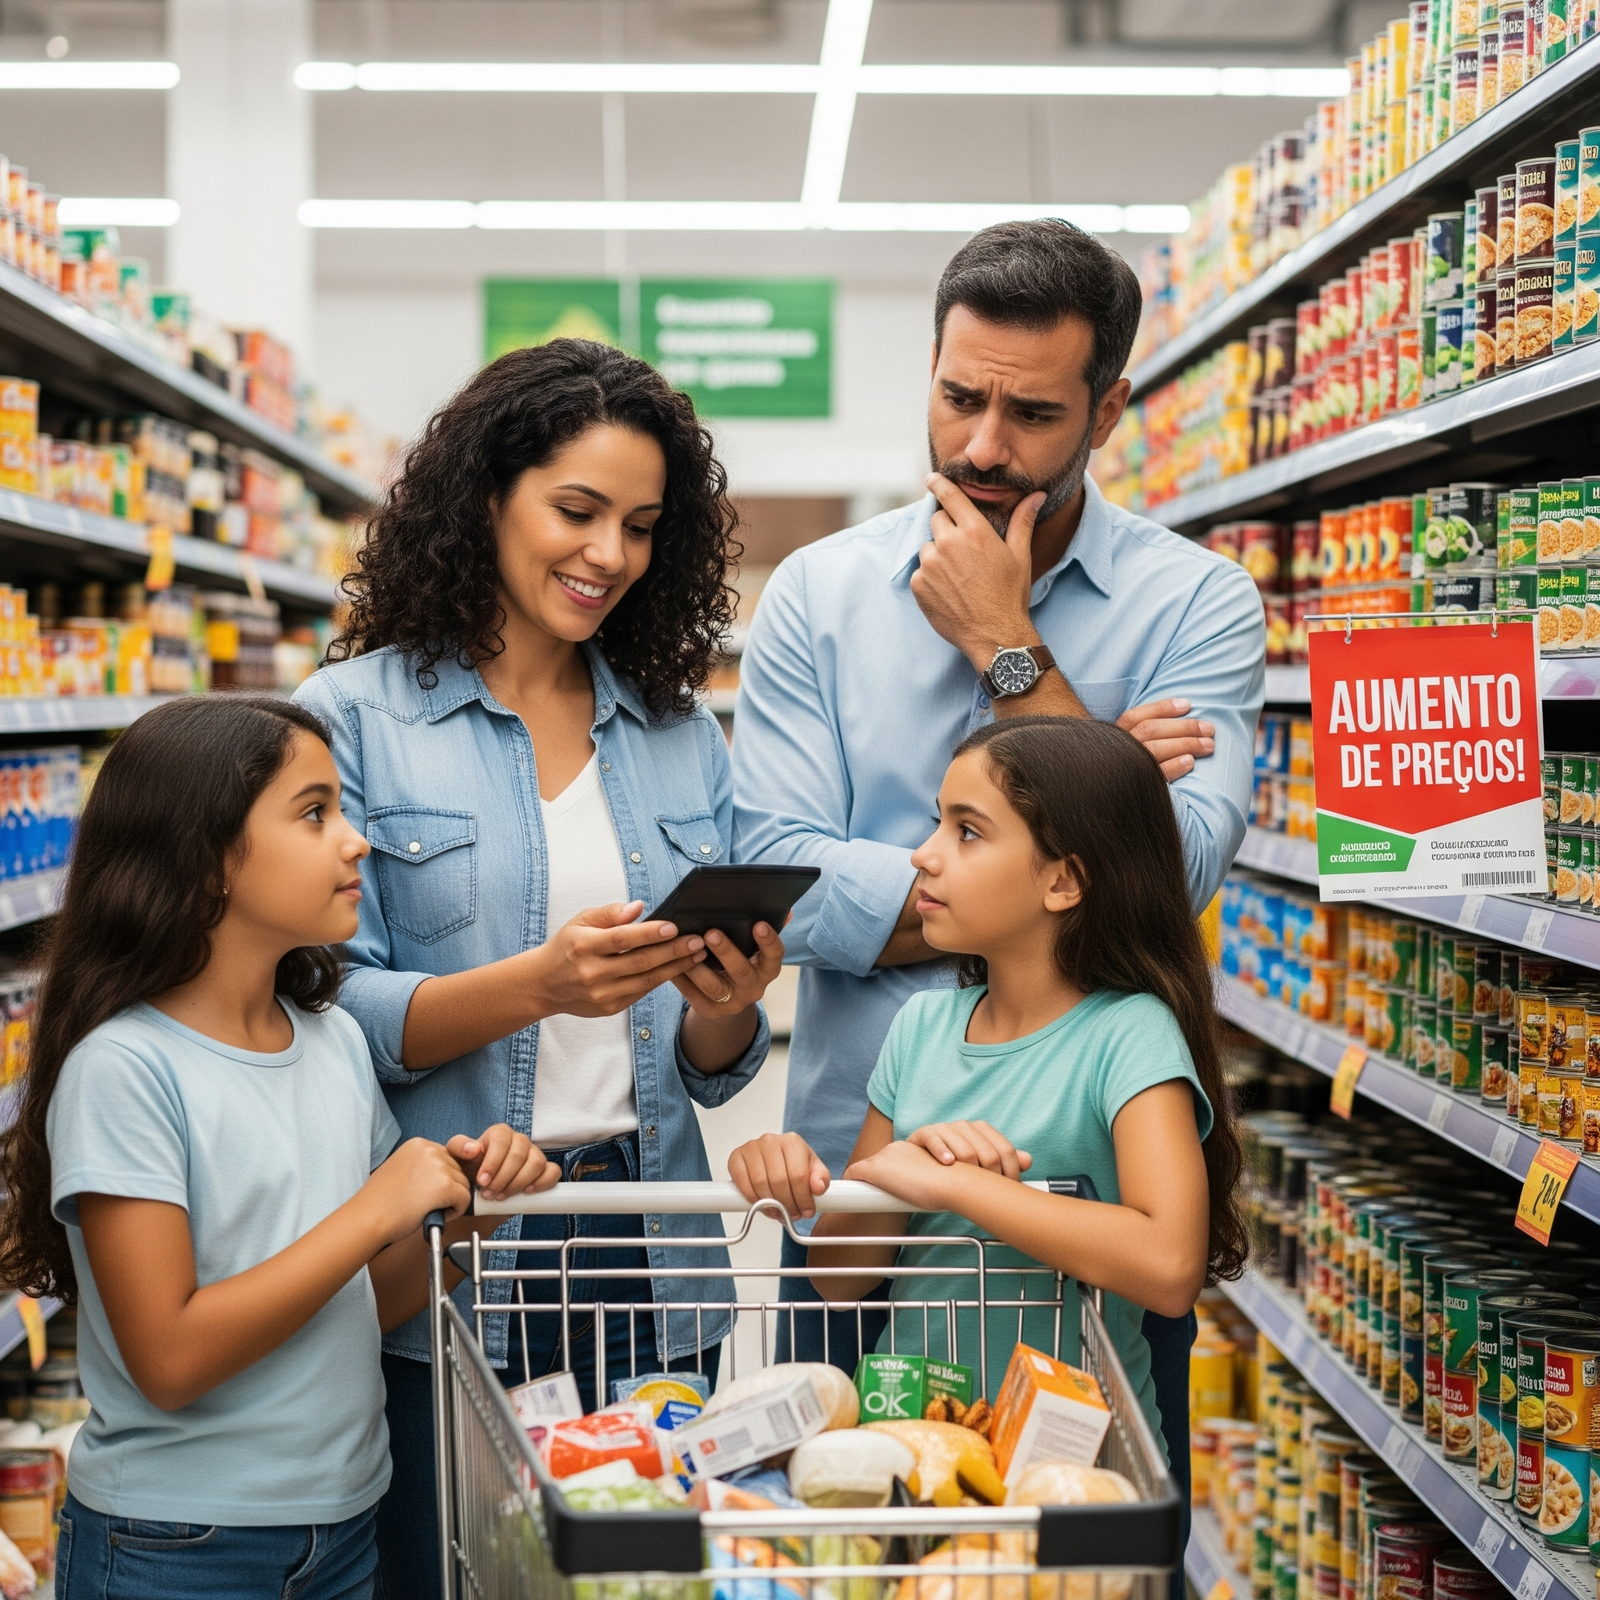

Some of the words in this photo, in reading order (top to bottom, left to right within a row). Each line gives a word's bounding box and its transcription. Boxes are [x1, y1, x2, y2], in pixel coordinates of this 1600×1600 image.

[1329, 673, 1521, 734] AUMENTO
[1340, 744, 1383, 788] DE
[1391, 739, 1526, 793] PREÇOS!
[864, 1391, 913, 1416] OK
